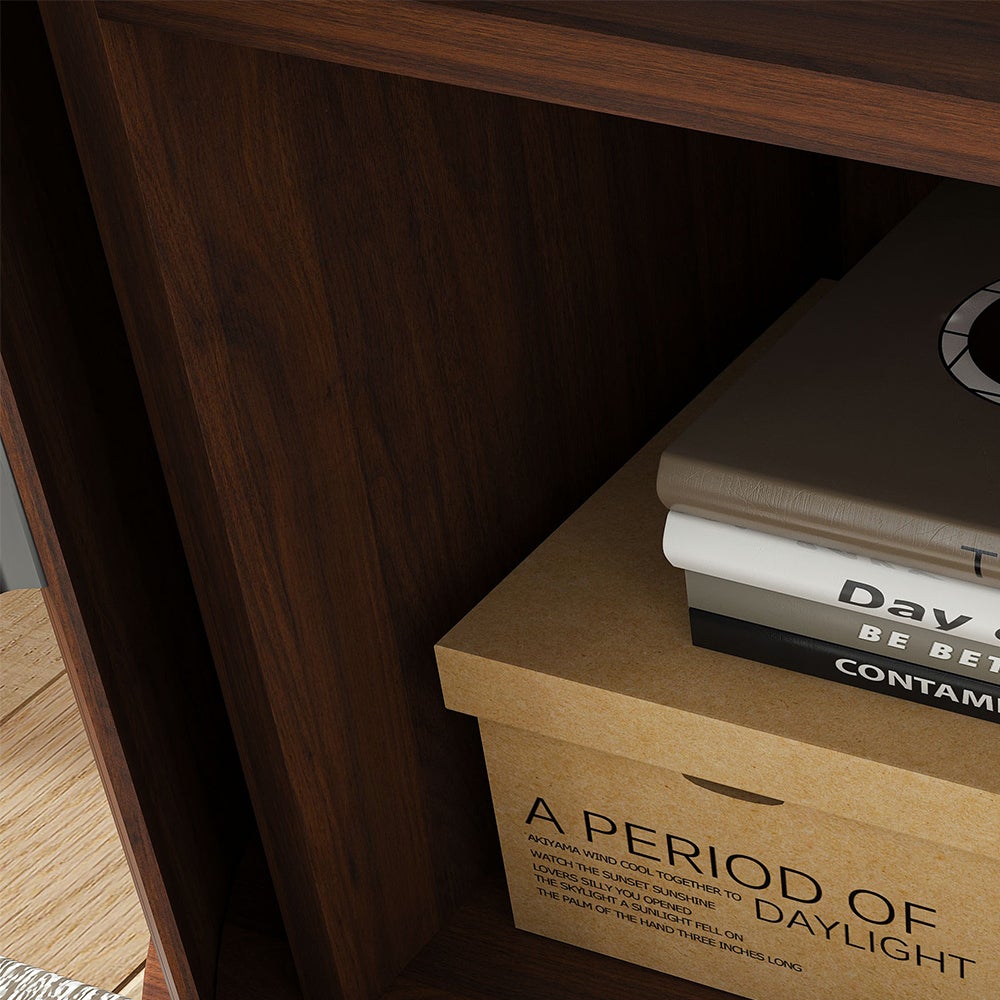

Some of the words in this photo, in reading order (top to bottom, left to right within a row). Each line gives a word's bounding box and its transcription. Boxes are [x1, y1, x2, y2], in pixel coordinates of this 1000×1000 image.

[838, 579, 972, 631] Day
[858, 623, 910, 651] BE
[525, 797, 565, 834] A
[583, 810, 822, 904] PERIOD
[848, 889, 937, 934] OF
[528, 834, 581, 855] AKIYAMA
[582, 849, 617, 865] WIND
[620, 860, 654, 877] COOL
[656, 870, 722, 896] TOGETHER
[724, 889, 742, 902] TO
[530, 848, 573, 868] WATCH
[575, 862, 600, 876] THE
[602, 870, 650, 890] SUNSET
[652, 885, 717, 911] SUNSHINE
[533, 863, 578, 883] LOVERS
[580, 877, 613, 892] SILLY
[615, 886, 641, 901] YOU
[643, 896, 692, 916] OPENED
[534, 874, 558, 887] THE
[560, 882, 617, 904] SKYLIGHT
[620, 900, 630, 908] A
[631, 903, 693, 926] SUNLIGHT
[695, 921, 723, 937] FELL
[724, 930, 744, 942] ON
[536, 887, 560, 901] THE
[562, 895, 593, 910] PALM
[595, 905, 611, 914] OF
[613, 910, 637, 923] THE
[640, 917, 674, 934] HAND
[677, 928, 717, 947] THREE
[719, 941, 765, 961] INCHES
[767, 956, 803, 972] LONG
[755, 898, 976, 979] DAYLIGHT
